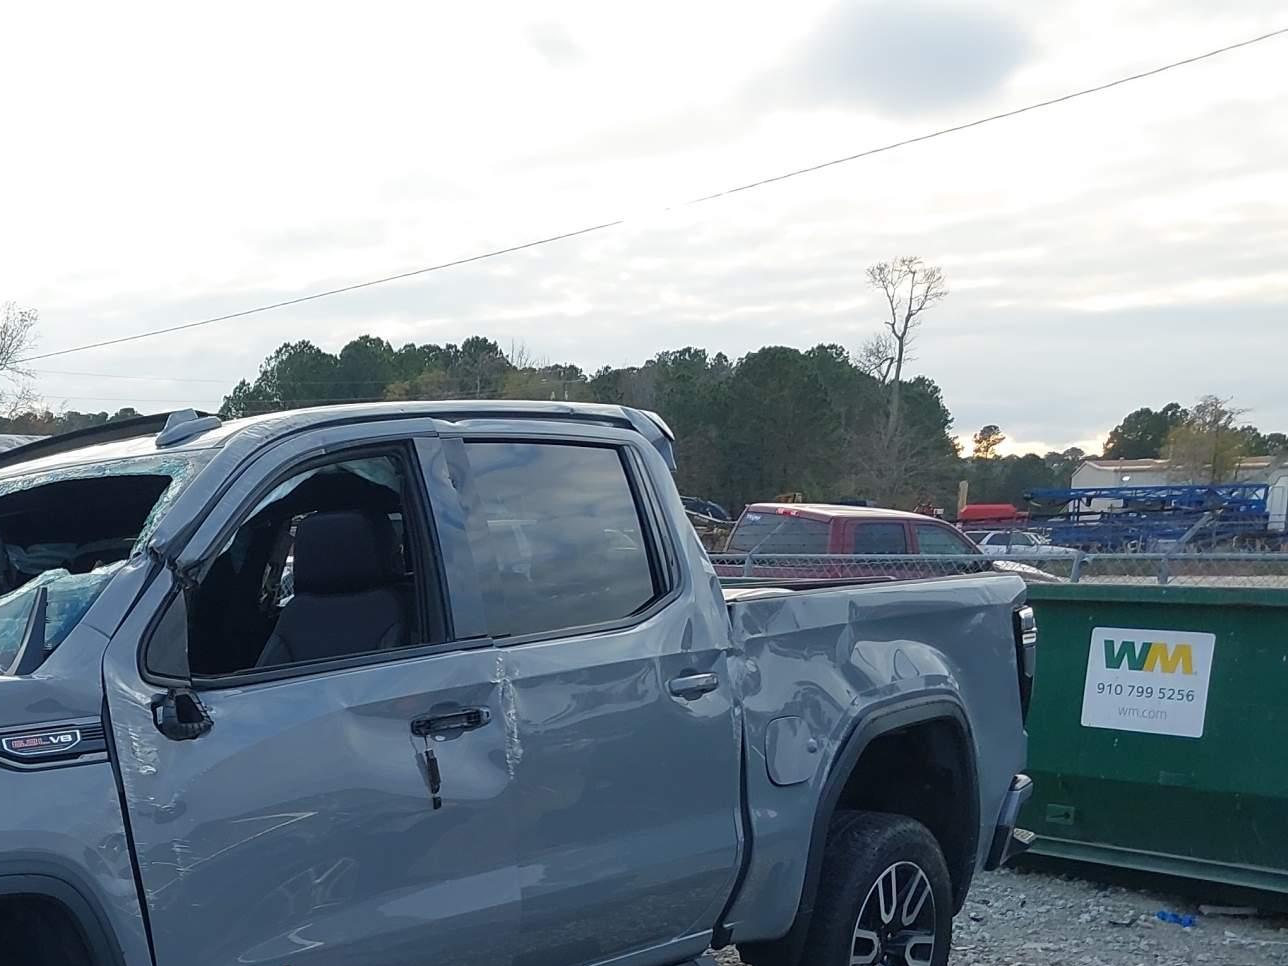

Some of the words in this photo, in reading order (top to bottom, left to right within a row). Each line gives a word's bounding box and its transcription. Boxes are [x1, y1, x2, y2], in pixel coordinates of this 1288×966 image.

[1103, 639, 1194, 675] WM
[1097, 682, 1123, 696] 910
[1127, 685, 1154, 699] 799
[1157, 687, 1195, 702] 5256
[1118, 706, 1168, 721] wm.com
[49, 734, 73, 744] V8
